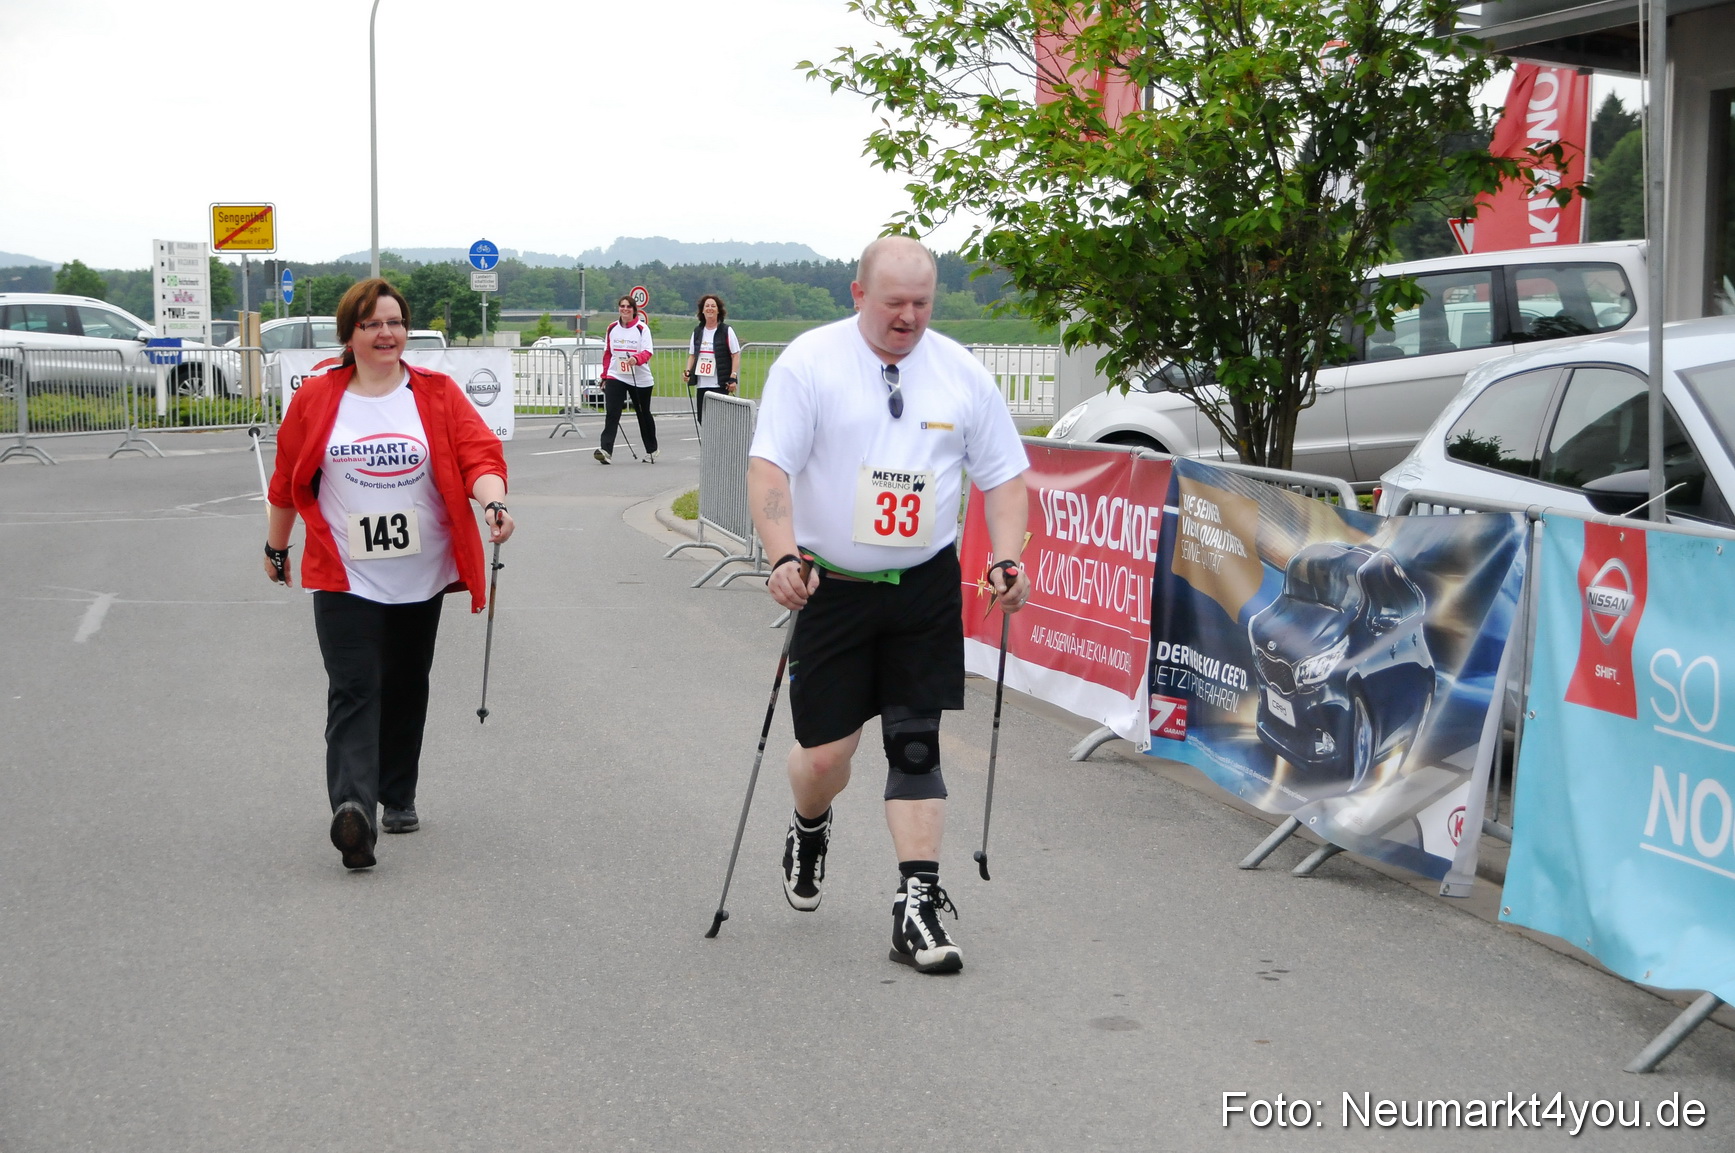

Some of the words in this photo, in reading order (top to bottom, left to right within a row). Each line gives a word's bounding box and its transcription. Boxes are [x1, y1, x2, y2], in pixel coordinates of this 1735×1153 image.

[218, 211, 268, 225] Sengenthal
[634, 292, 645, 303] 60
[700, 363, 712, 375] 98
[468, 383, 499, 392] NISSAN
[329, 442, 408, 457] GERHART
[366, 453, 419, 467] JÄNIG
[344, 472, 359, 484] Das
[359, 479, 396, 490] sportliche
[397, 471, 426, 488] Autohaus
[871, 479, 911, 491] WERBUNG
[872, 470, 911, 483] MEYER
[873, 491, 921, 538] 33
[359, 512, 410, 553] 143
[1587, 591, 1629, 612] NISSAN
[1030, 624, 1046, 646] AUF
[1093, 644, 1107, 664] KIA
[1156, 640, 1189, 665] DER
[1201, 655, 1220, 681] KIA
[1649, 648, 1721, 733] SO
[1149, 699, 1178, 731] 7
[1643, 764, 1735, 858] NO
